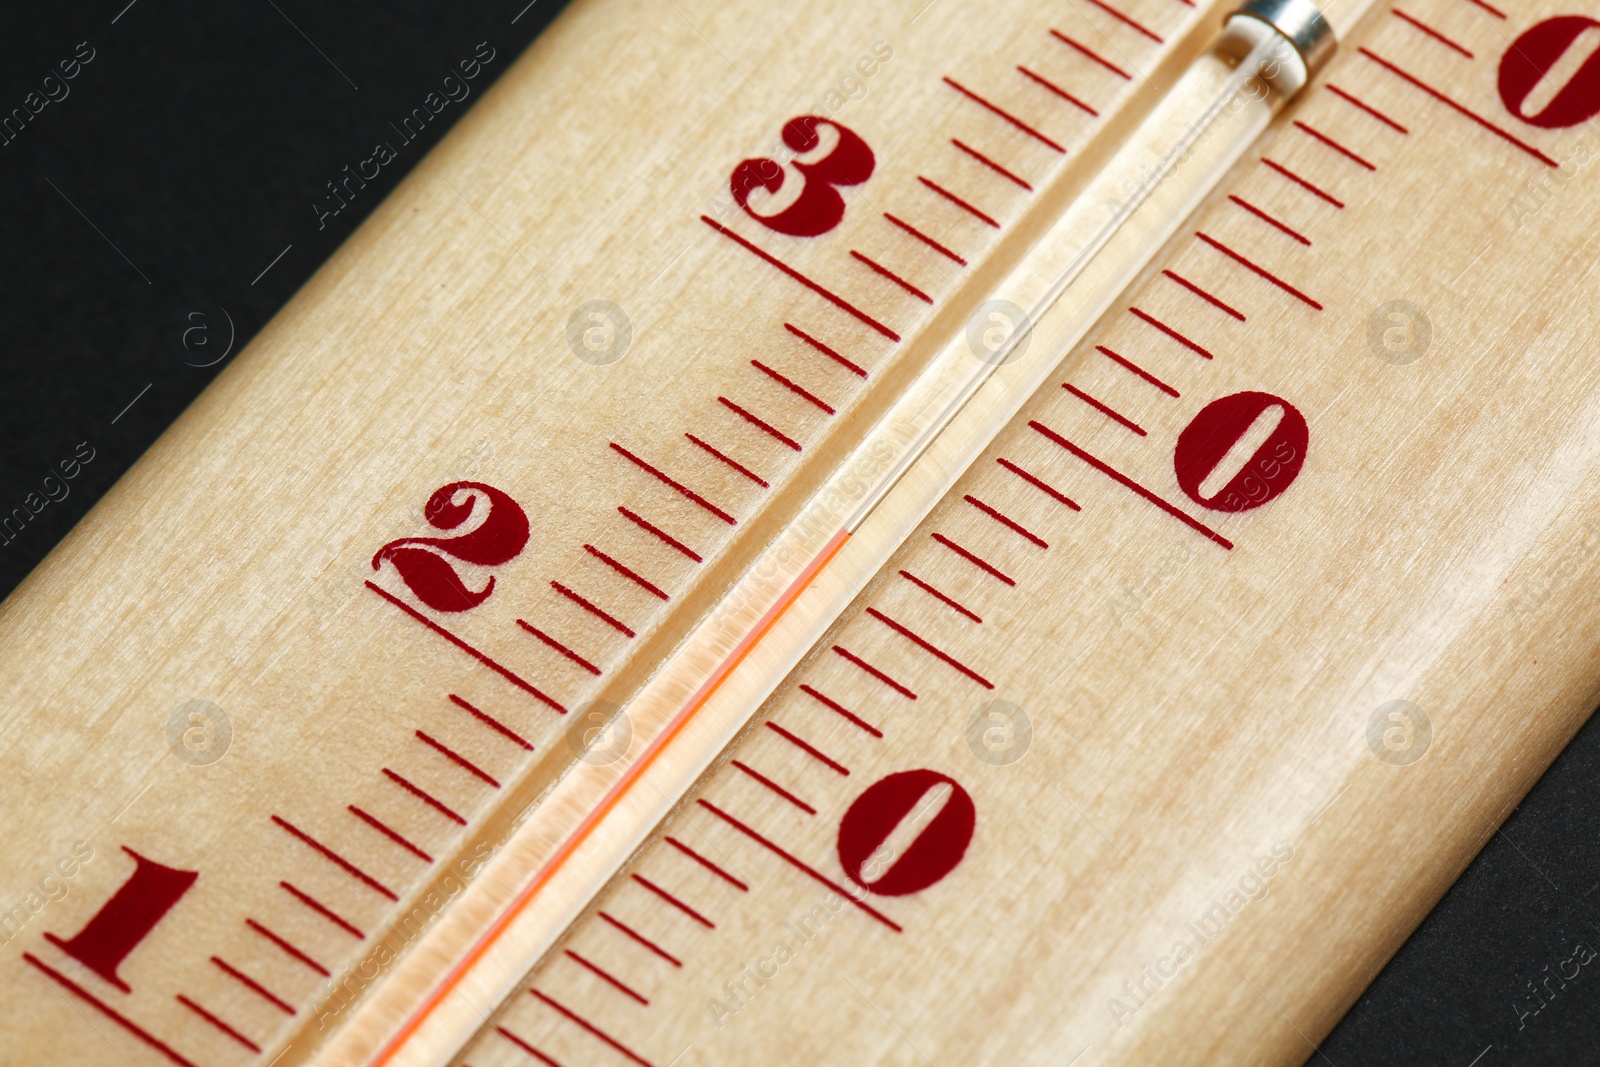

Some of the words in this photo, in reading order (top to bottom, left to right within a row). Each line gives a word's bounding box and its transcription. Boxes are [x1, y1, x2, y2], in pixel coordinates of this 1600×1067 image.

[730, 115, 875, 237] 3
[1174, 391, 1309, 513] 0
[371, 480, 530, 613] 2
[837, 768, 976, 897] 0
[43, 845, 199, 994] 1
